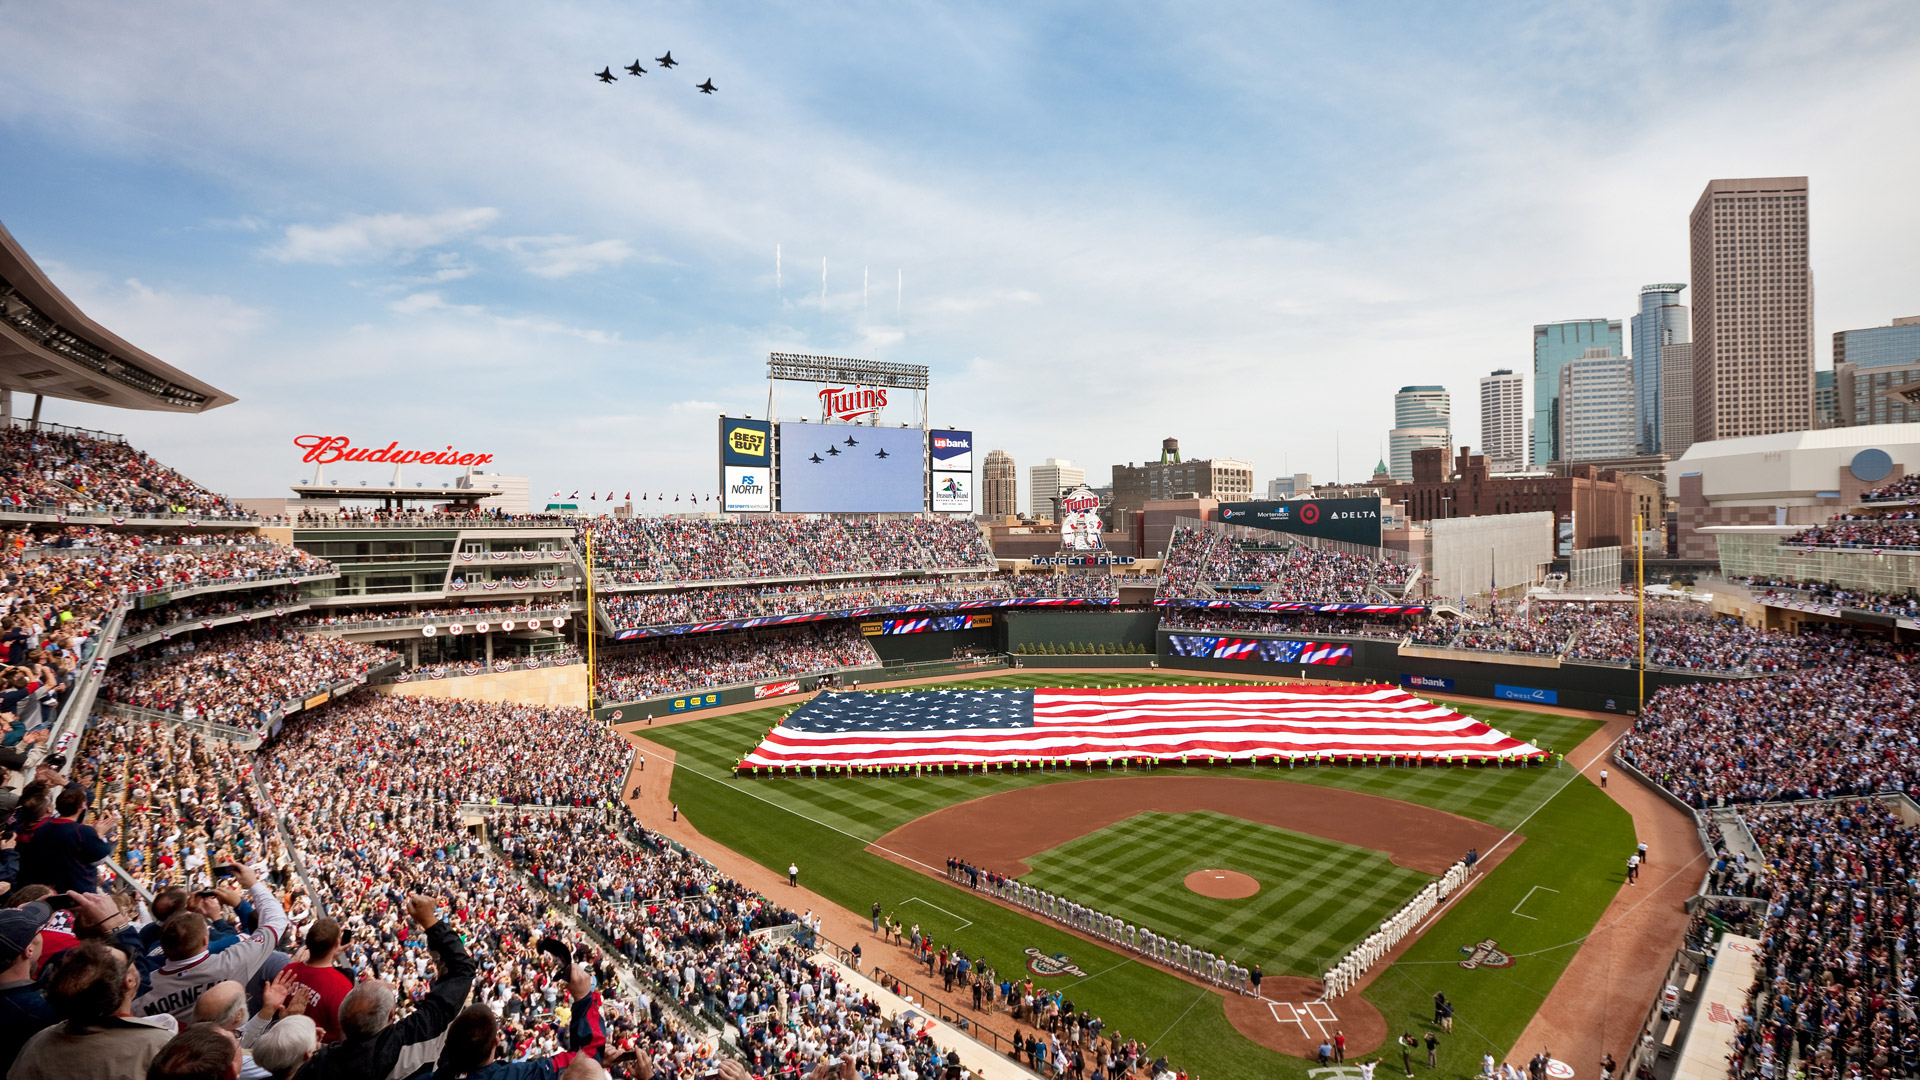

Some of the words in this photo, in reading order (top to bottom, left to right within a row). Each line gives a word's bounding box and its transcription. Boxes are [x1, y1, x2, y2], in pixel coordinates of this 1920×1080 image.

[818, 384, 888, 418] Twins
[733, 432, 764, 444] BEST
[293, 434, 494, 466] Budweiser
[734, 440, 761, 452] BUY
[741, 475, 754, 485] FS
[731, 484, 763, 495] NORTH
[1062, 496, 1099, 514] Twins
[1341, 511, 1376, 519] DELTA
[1030, 557, 1084, 565] TARGET
[1097, 557, 1136, 565] FIELD
[758, 681, 800, 699] Budweiser
[1506, 690, 1531, 699] Qwest
